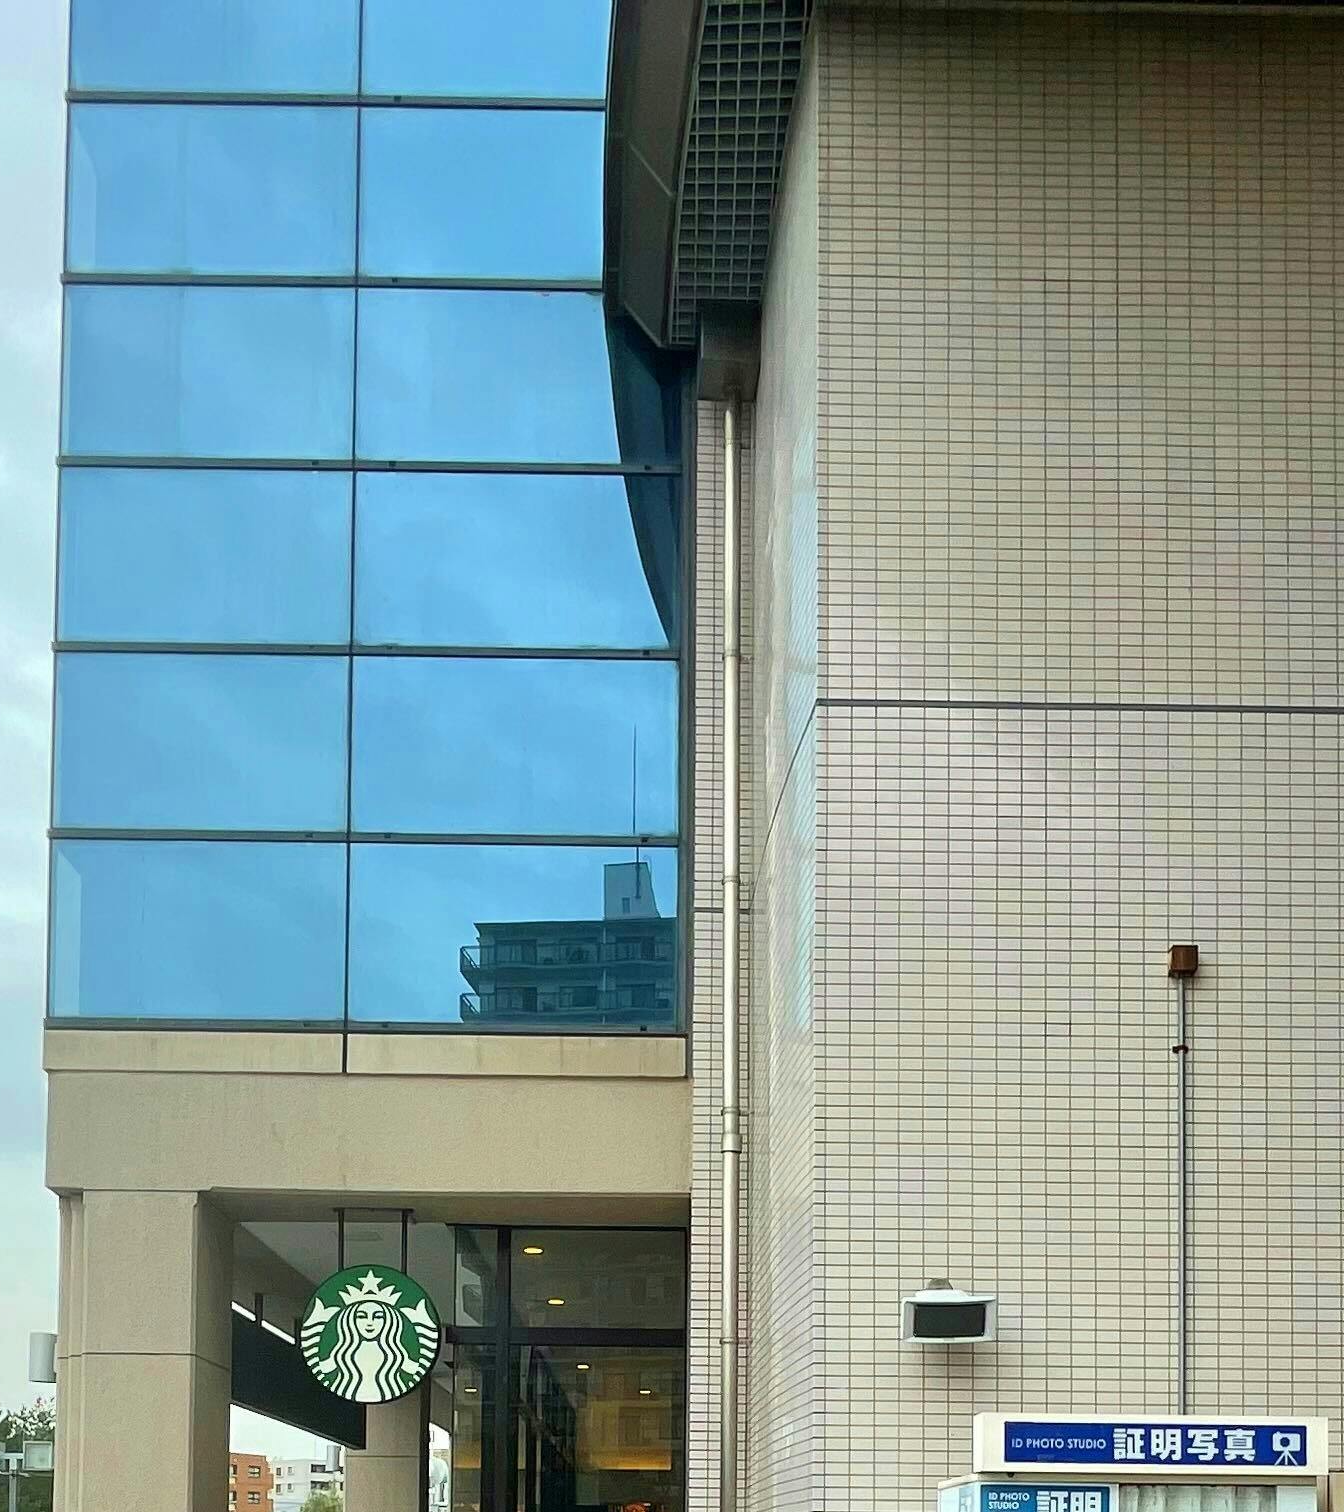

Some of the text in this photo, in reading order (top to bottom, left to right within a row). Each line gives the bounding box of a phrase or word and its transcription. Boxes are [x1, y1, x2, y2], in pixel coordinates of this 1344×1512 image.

[1011, 1426, 1257, 1462] ID PHOTO STUDIO 証明写真
[988, 1492, 1030, 1501] ID PHOTO
[988, 1502, 1019, 1510] STUDIO
